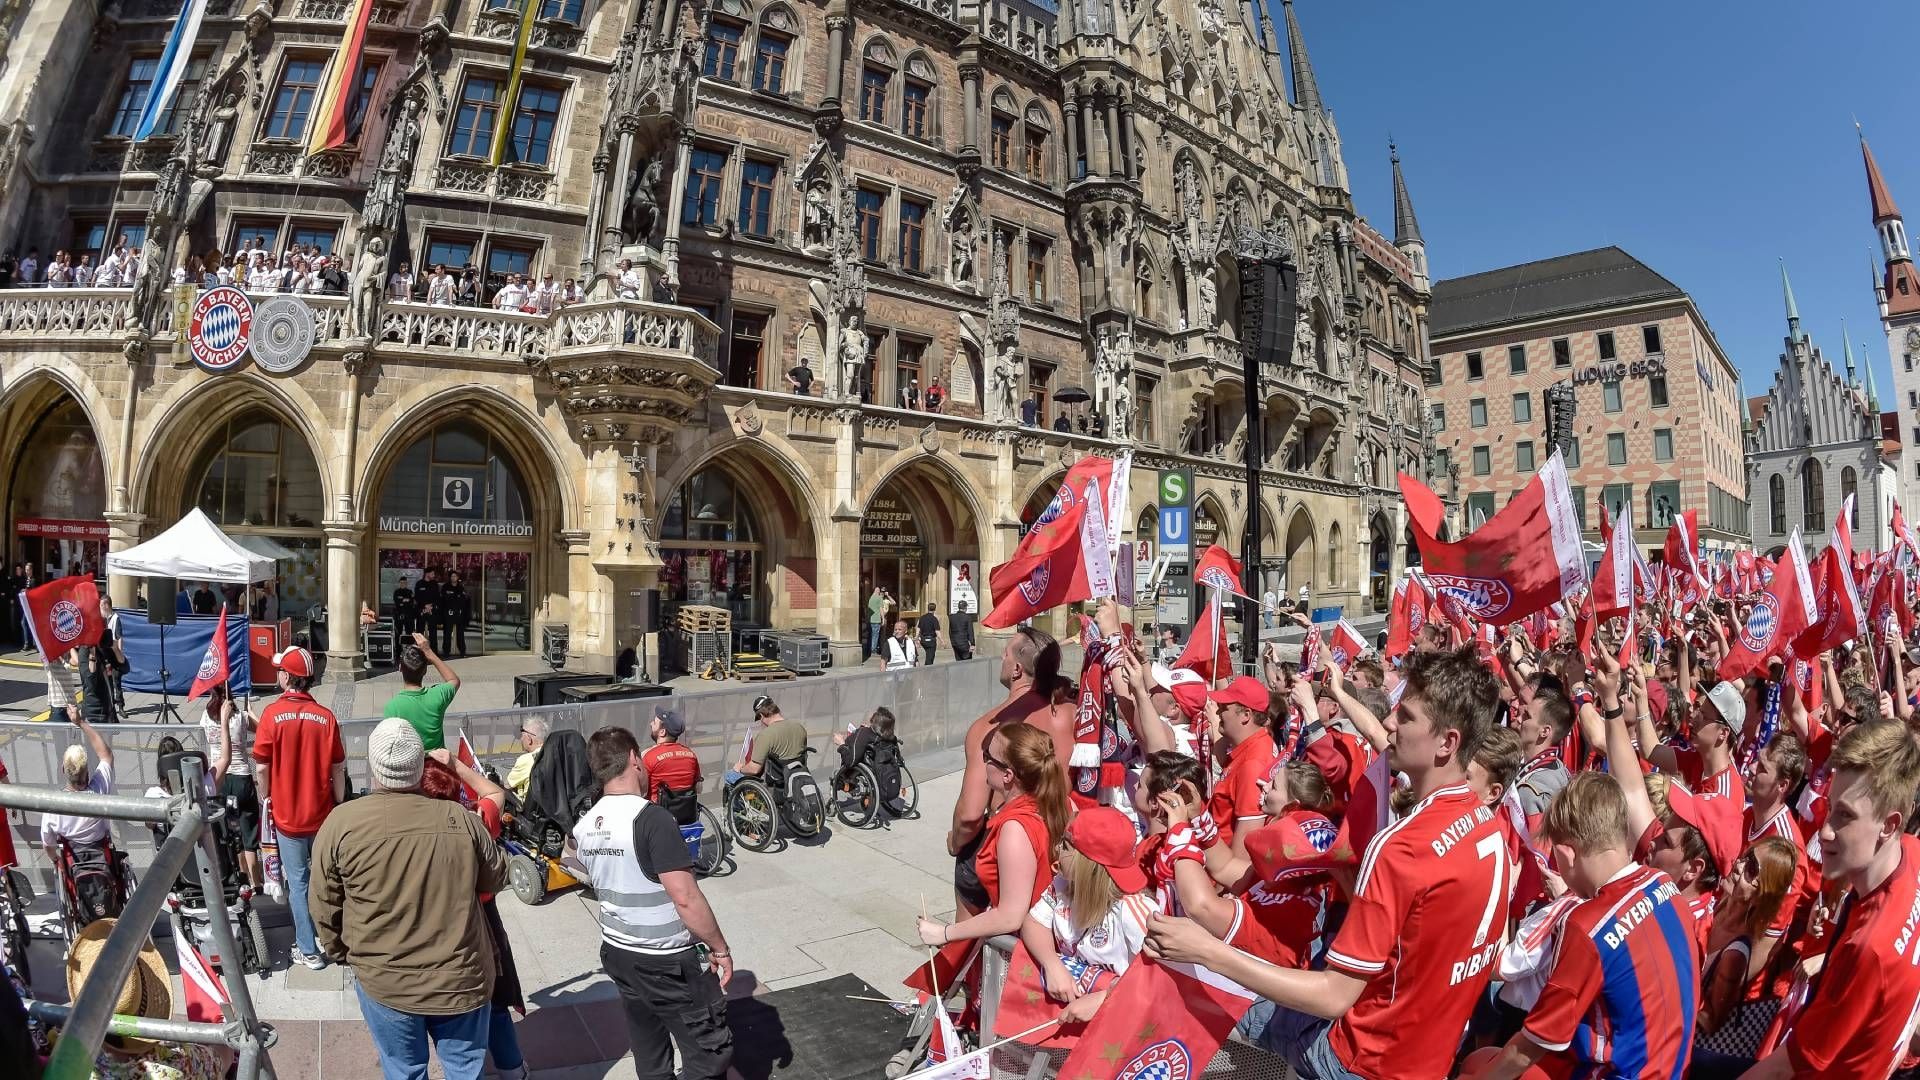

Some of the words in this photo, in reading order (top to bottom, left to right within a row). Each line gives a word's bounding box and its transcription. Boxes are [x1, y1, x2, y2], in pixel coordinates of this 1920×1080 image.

[193, 303, 208, 322] FC
[208, 291, 251, 322] BAYERN
[191, 335, 248, 365] MÜNCHEN
[1573, 363, 1627, 383] LUDWIG
[1631, 359, 1666, 375] BECK
[1165, 474, 1183, 502] S
[864, 511, 912, 521] ERNSTEIN
[873, 500, 896, 509] 1884
[89, 527, 110, 535] SANDWIC
[379, 517, 446, 534] München
[451, 520, 533, 537] Information
[867, 521, 901, 529] LADEN
[1165, 511, 1182, 539] U
[887, 534, 918, 543] HOUSE
[274, 712, 297, 724] BAYERN
[1431, 812, 1475, 858] BAYERN
[1475, 829, 1505, 949] 7
[1603, 896, 1654, 950] BAYERN
